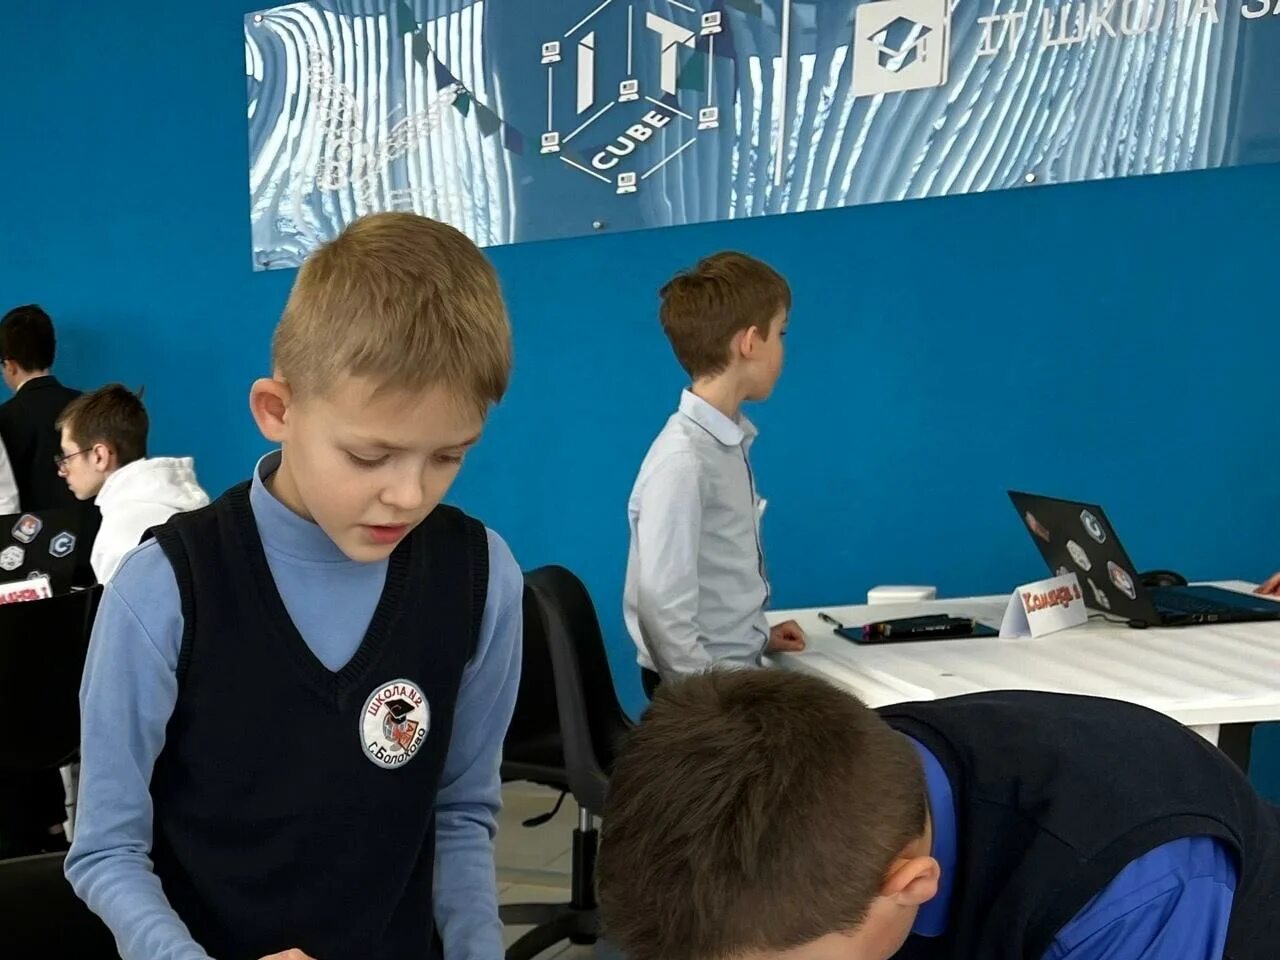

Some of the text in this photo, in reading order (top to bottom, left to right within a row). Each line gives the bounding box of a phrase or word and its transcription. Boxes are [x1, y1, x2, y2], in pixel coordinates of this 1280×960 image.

[976, 11, 1026, 56] IT
[592, 110, 671, 170] CUBE
[368, 686, 407, 717] ШКОЛА
